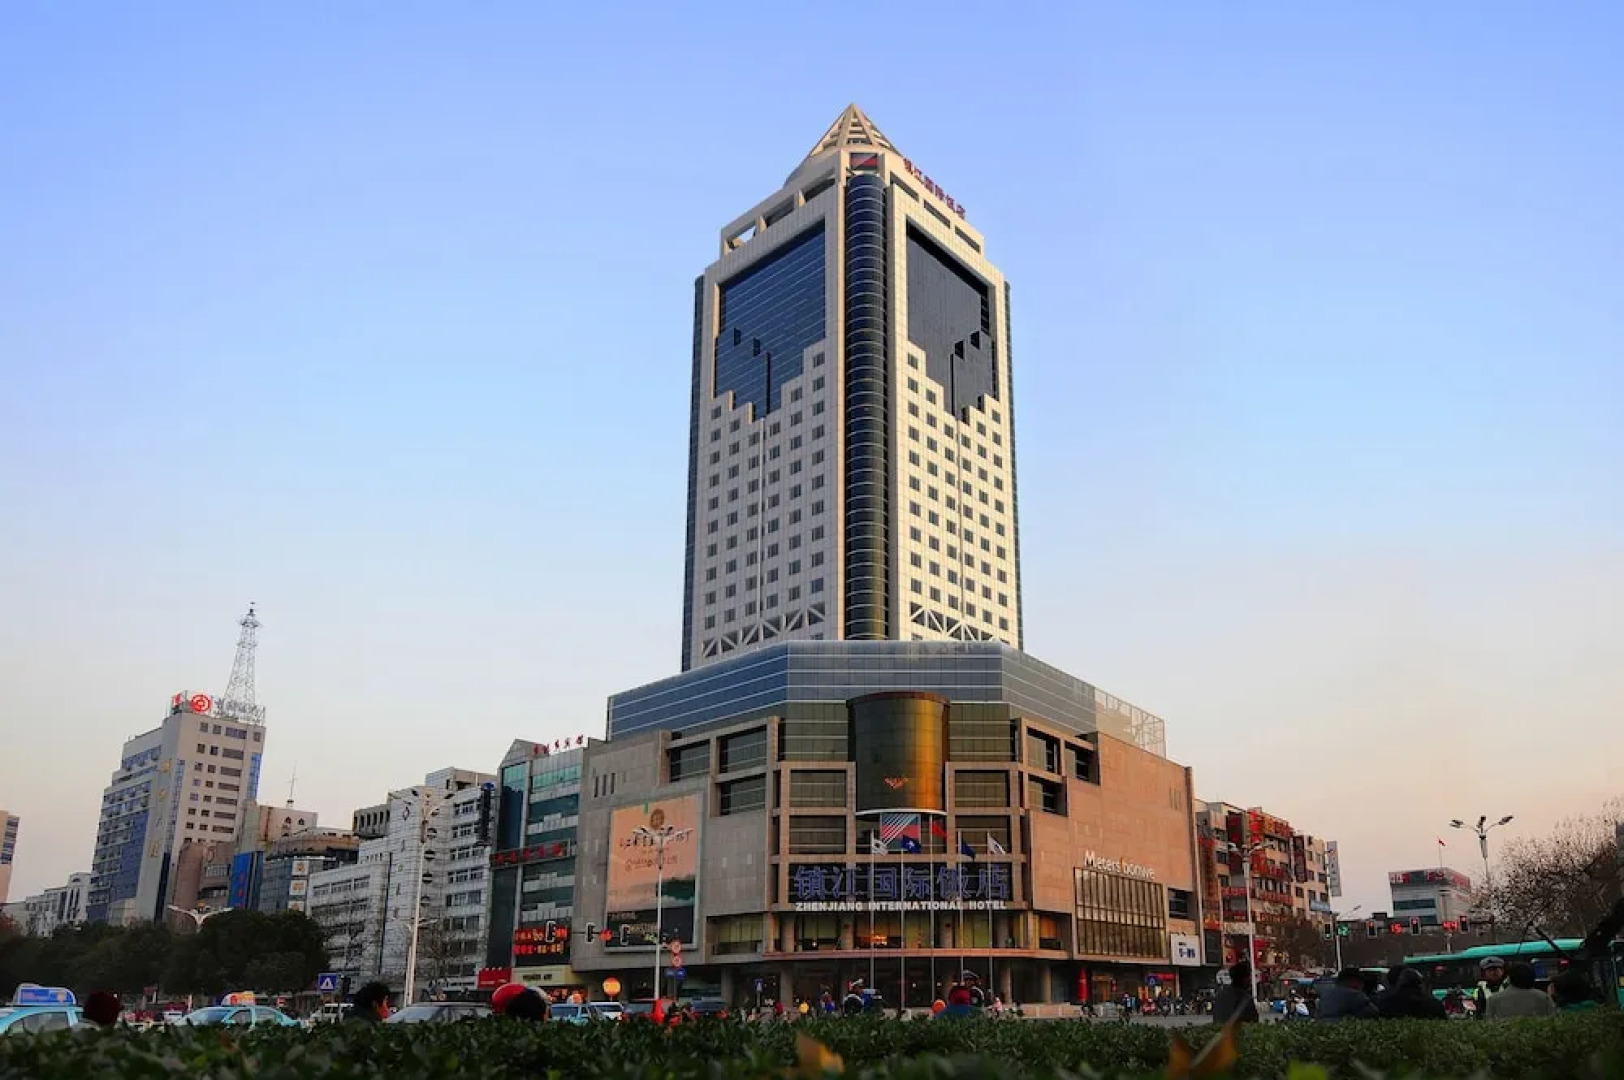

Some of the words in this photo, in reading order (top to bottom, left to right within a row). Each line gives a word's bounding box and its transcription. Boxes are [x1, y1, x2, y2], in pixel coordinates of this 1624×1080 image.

[794, 865, 1009, 900] 镇江国际饭店
[795, 901, 863, 912] ZHENJIANG
[868, 901, 964, 911] INTERNATIONAL
[968, 900, 1008, 910] HOTEL
